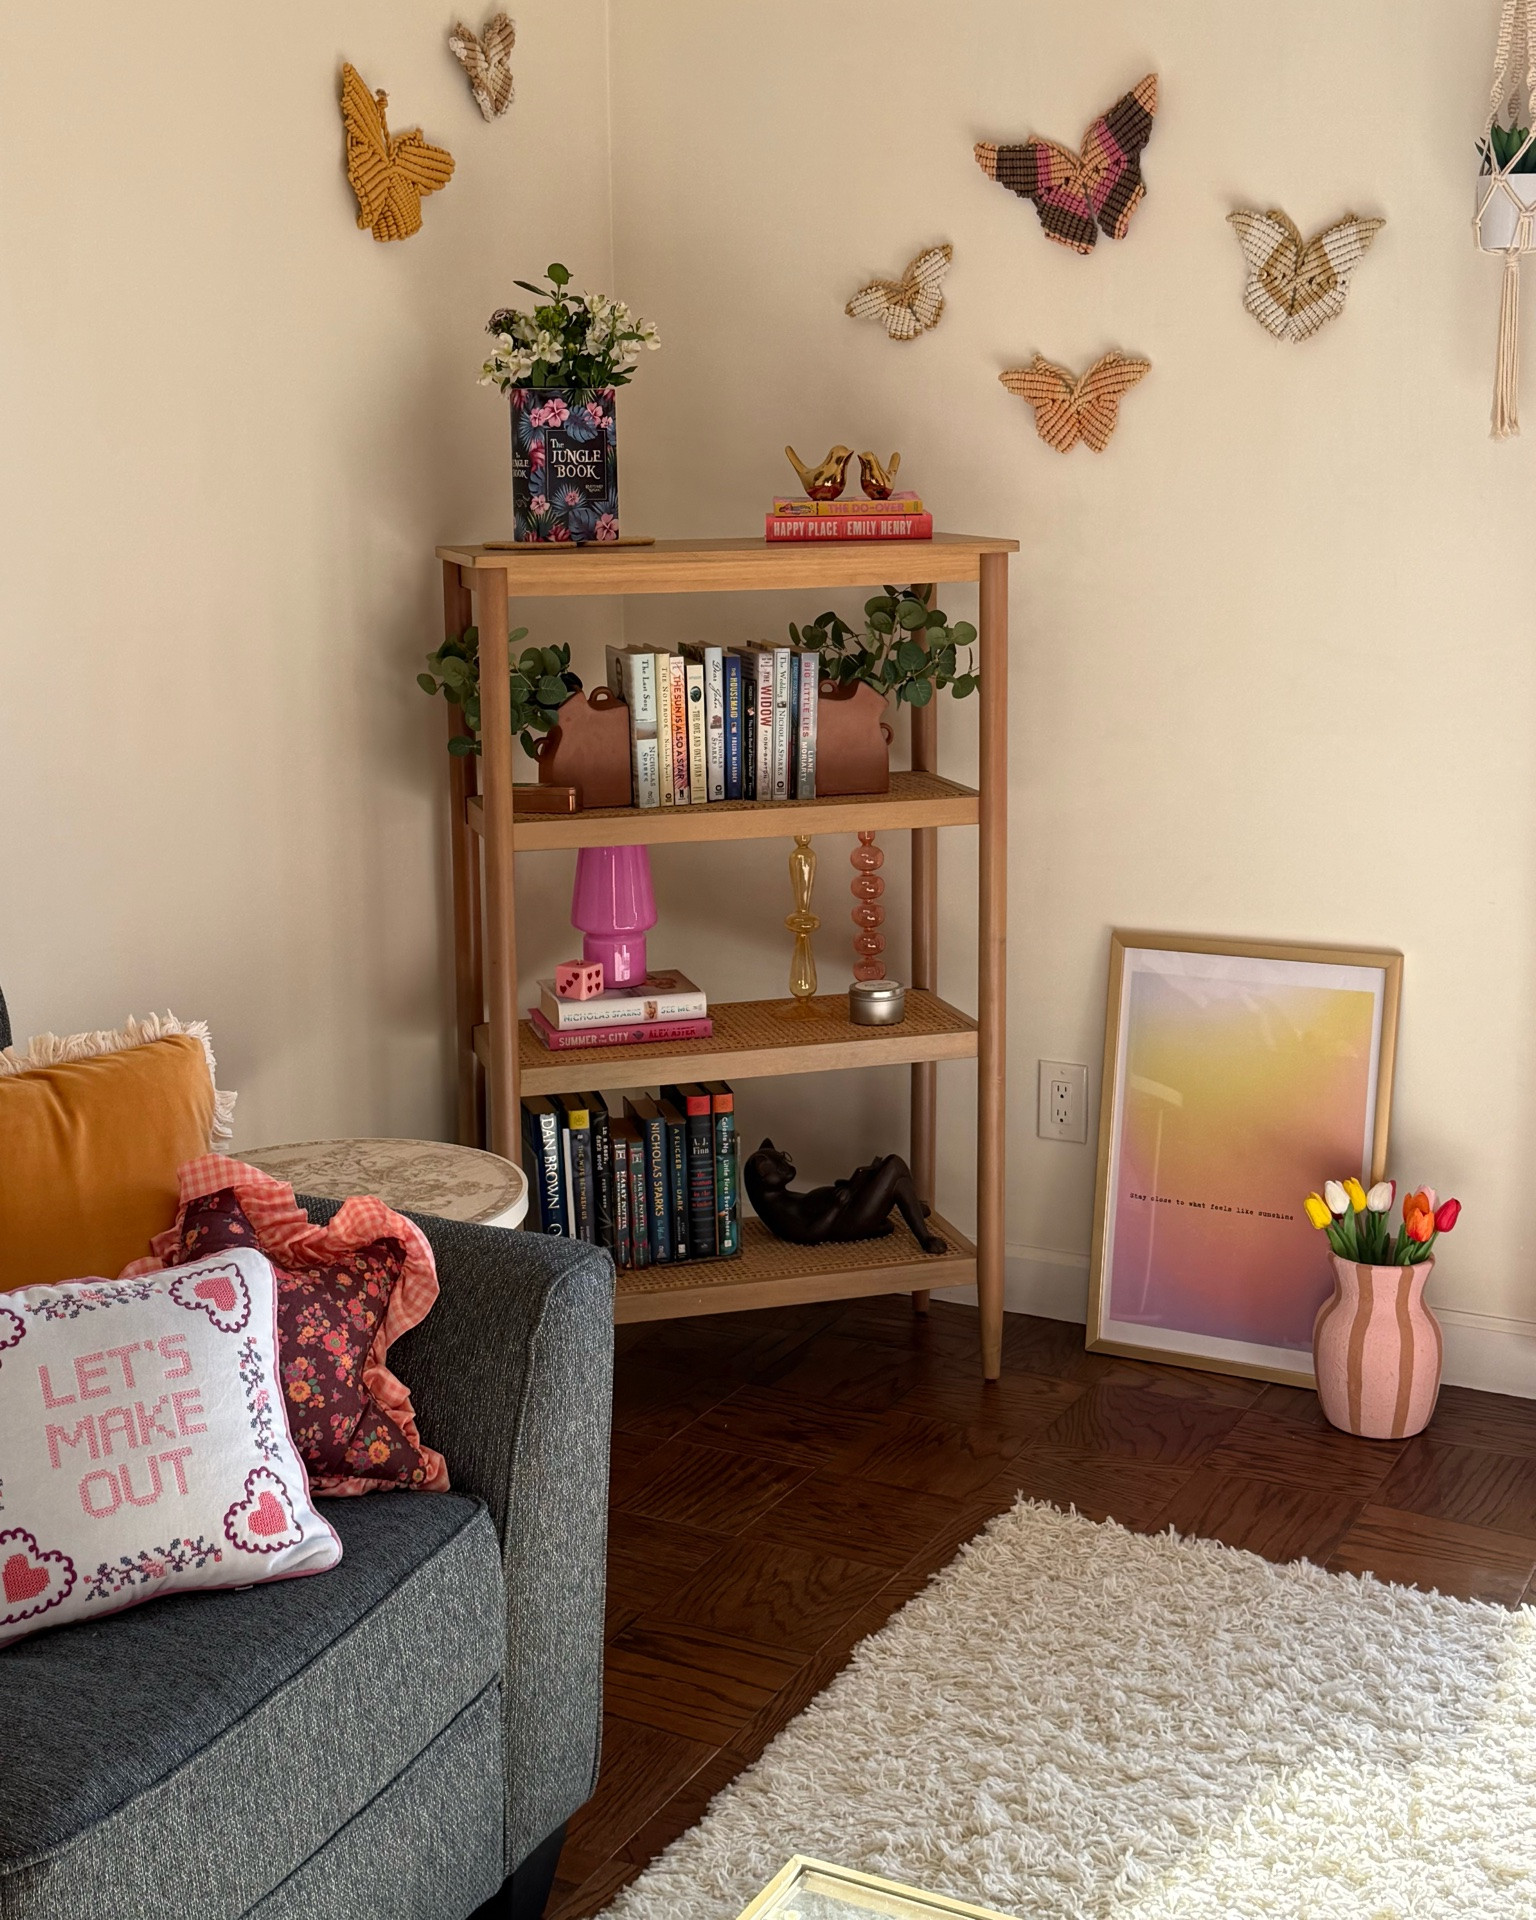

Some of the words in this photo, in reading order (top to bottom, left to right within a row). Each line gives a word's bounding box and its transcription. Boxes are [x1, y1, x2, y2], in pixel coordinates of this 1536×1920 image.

[550, 438, 565, 449] The
[550, 448, 603, 466] JUNGLE
[553, 465, 601, 480] BOOK
[827, 503, 849, 513] THE
[852, 502, 905, 513] DO-OVER
[773, 521, 805, 537] HAPPY
[807, 520, 838, 536] PLACE
[846, 520, 878, 536] EMILY
[880, 520, 913, 536] HENRY
[641, 659, 649, 674] The
[712, 659, 722, 682] Dear
[803, 661, 811, 678] BIG
[642, 676, 650, 692] Last
[673, 675, 682, 693] THE
[777, 670, 787, 698] Wedding
[641, 694, 651, 712] Song
[674, 694, 682, 714] SUN
[708, 682, 723, 709] John
[729, 677, 738, 719] HOUSEMAID
[802, 682, 810, 714] LITTLE
[759, 685, 772, 727] WIDOW
[674, 715, 683, 723] IS
[692, 710, 701, 722] THE
[675, 725, 684, 749] ALSO
[693, 722, 701, 734] ONE
[778, 709, 786, 747] NICHOLAS
[802, 717, 810, 738] LIES
[693, 736, 701, 747] AND
[693, 748, 702, 763] ONLY
[777, 748, 785, 776] SPARKS
[648, 746, 656, 787] NICHOLAS
[676, 758, 685, 781] STAR
[694, 764, 702, 778] IVAN
[563, 1011, 610, 1022] NICHOLAS
[558, 1034, 598, 1047] SUMMER
[608, 1031, 629, 1043] CITY
[648, 1028, 669, 1039] ALEX
[670, 1025, 696, 1037] ASTER
[541, 1117, 556, 1151] DAN
[721, 1116, 729, 1142] Celeste
[650, 1122, 663, 1178] NICHOLAS
[692, 1138, 700, 1146] A.
[701, 1137, 709, 1146] J.
[692, 1146, 710, 1155] Finn
[721, 1142, 729, 1154] Ng
[674, 1135, 682, 1170] FLICKER
[578, 1159, 586, 1178] WIFE
[543, 1154, 560, 1210] BROWN
[723, 1178, 731, 1194] Fires
[579, 1178, 587, 1210] BETWEEN
[653, 1181, 665, 1217] SPARKS
[676, 1189, 684, 1211] DARK
[581, 1210, 588, 1220] US
[1129, 1192, 1147, 1202] Stay
[1150, 1195, 1172, 1205] close
[1176, 1198, 1185, 1206] to
[1188, 1200, 1206, 1210] what
[1210, 1203, 1232, 1213] feels
[1236, 1207, 1254, 1216] like
[1258, 1210, 1295, 1221] sunshine
[723, 1196, 732, 1237] Everywhere
[37, 1333, 195, 1410] LET'S
[45, 1388, 208, 1470] MAKE
[77, 1446, 193, 1519] OUT
